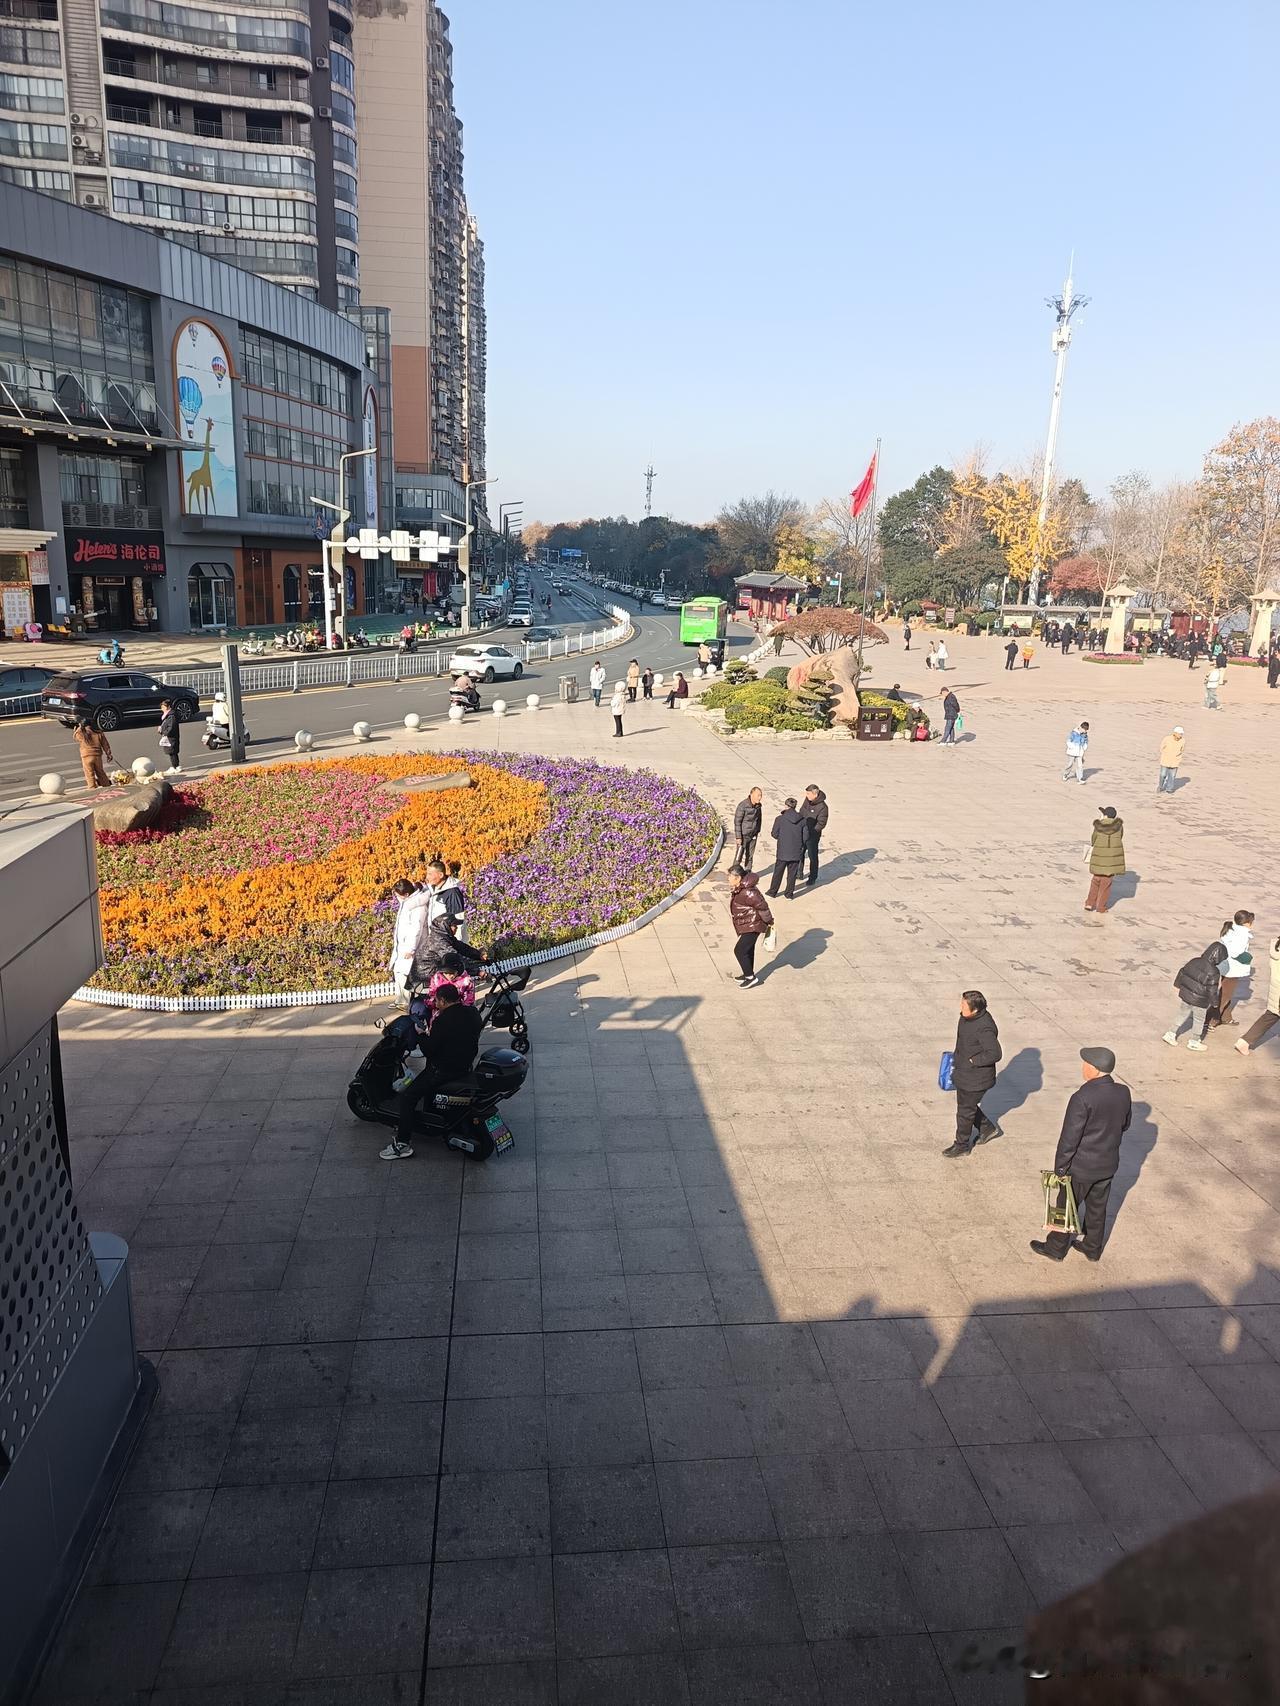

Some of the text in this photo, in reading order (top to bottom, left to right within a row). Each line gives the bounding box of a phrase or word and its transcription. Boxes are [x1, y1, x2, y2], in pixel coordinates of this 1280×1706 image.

[74, 539, 160, 562] Helen's 海伦司
